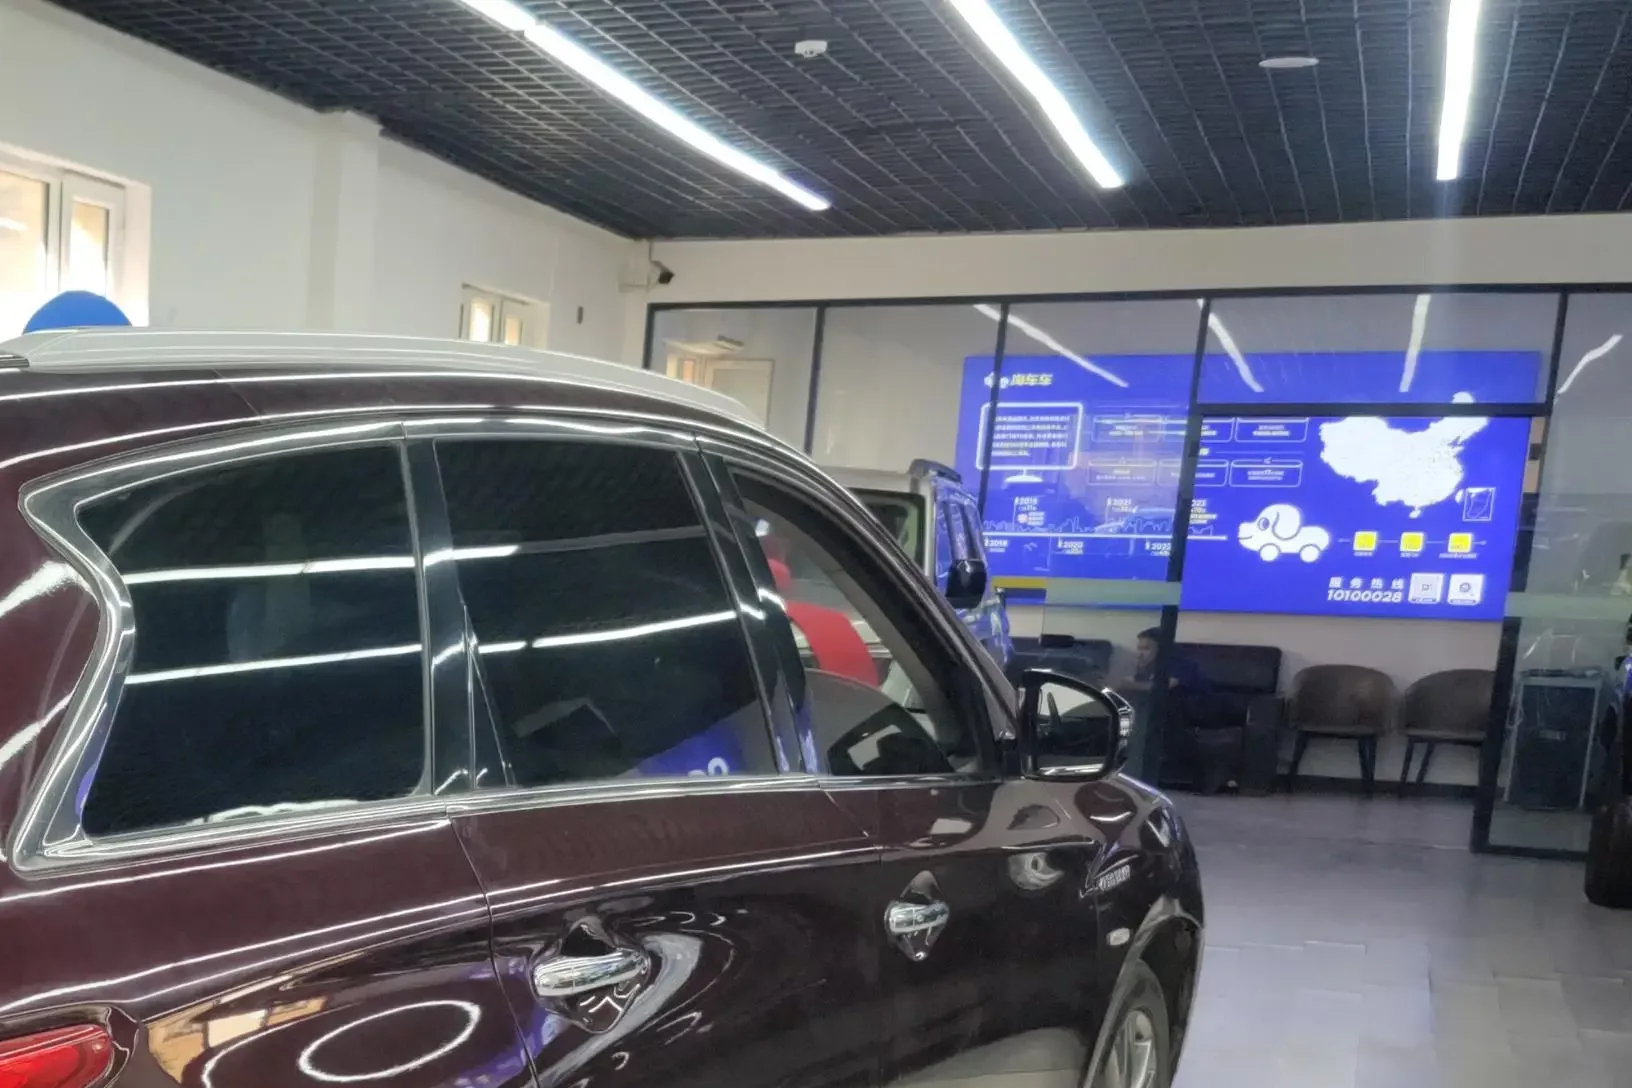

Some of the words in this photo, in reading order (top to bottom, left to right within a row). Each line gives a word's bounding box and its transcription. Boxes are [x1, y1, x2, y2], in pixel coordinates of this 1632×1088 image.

[1329, 576, 1404, 589] 服务热线
[1327, 589, 1403, 602] 10100028
